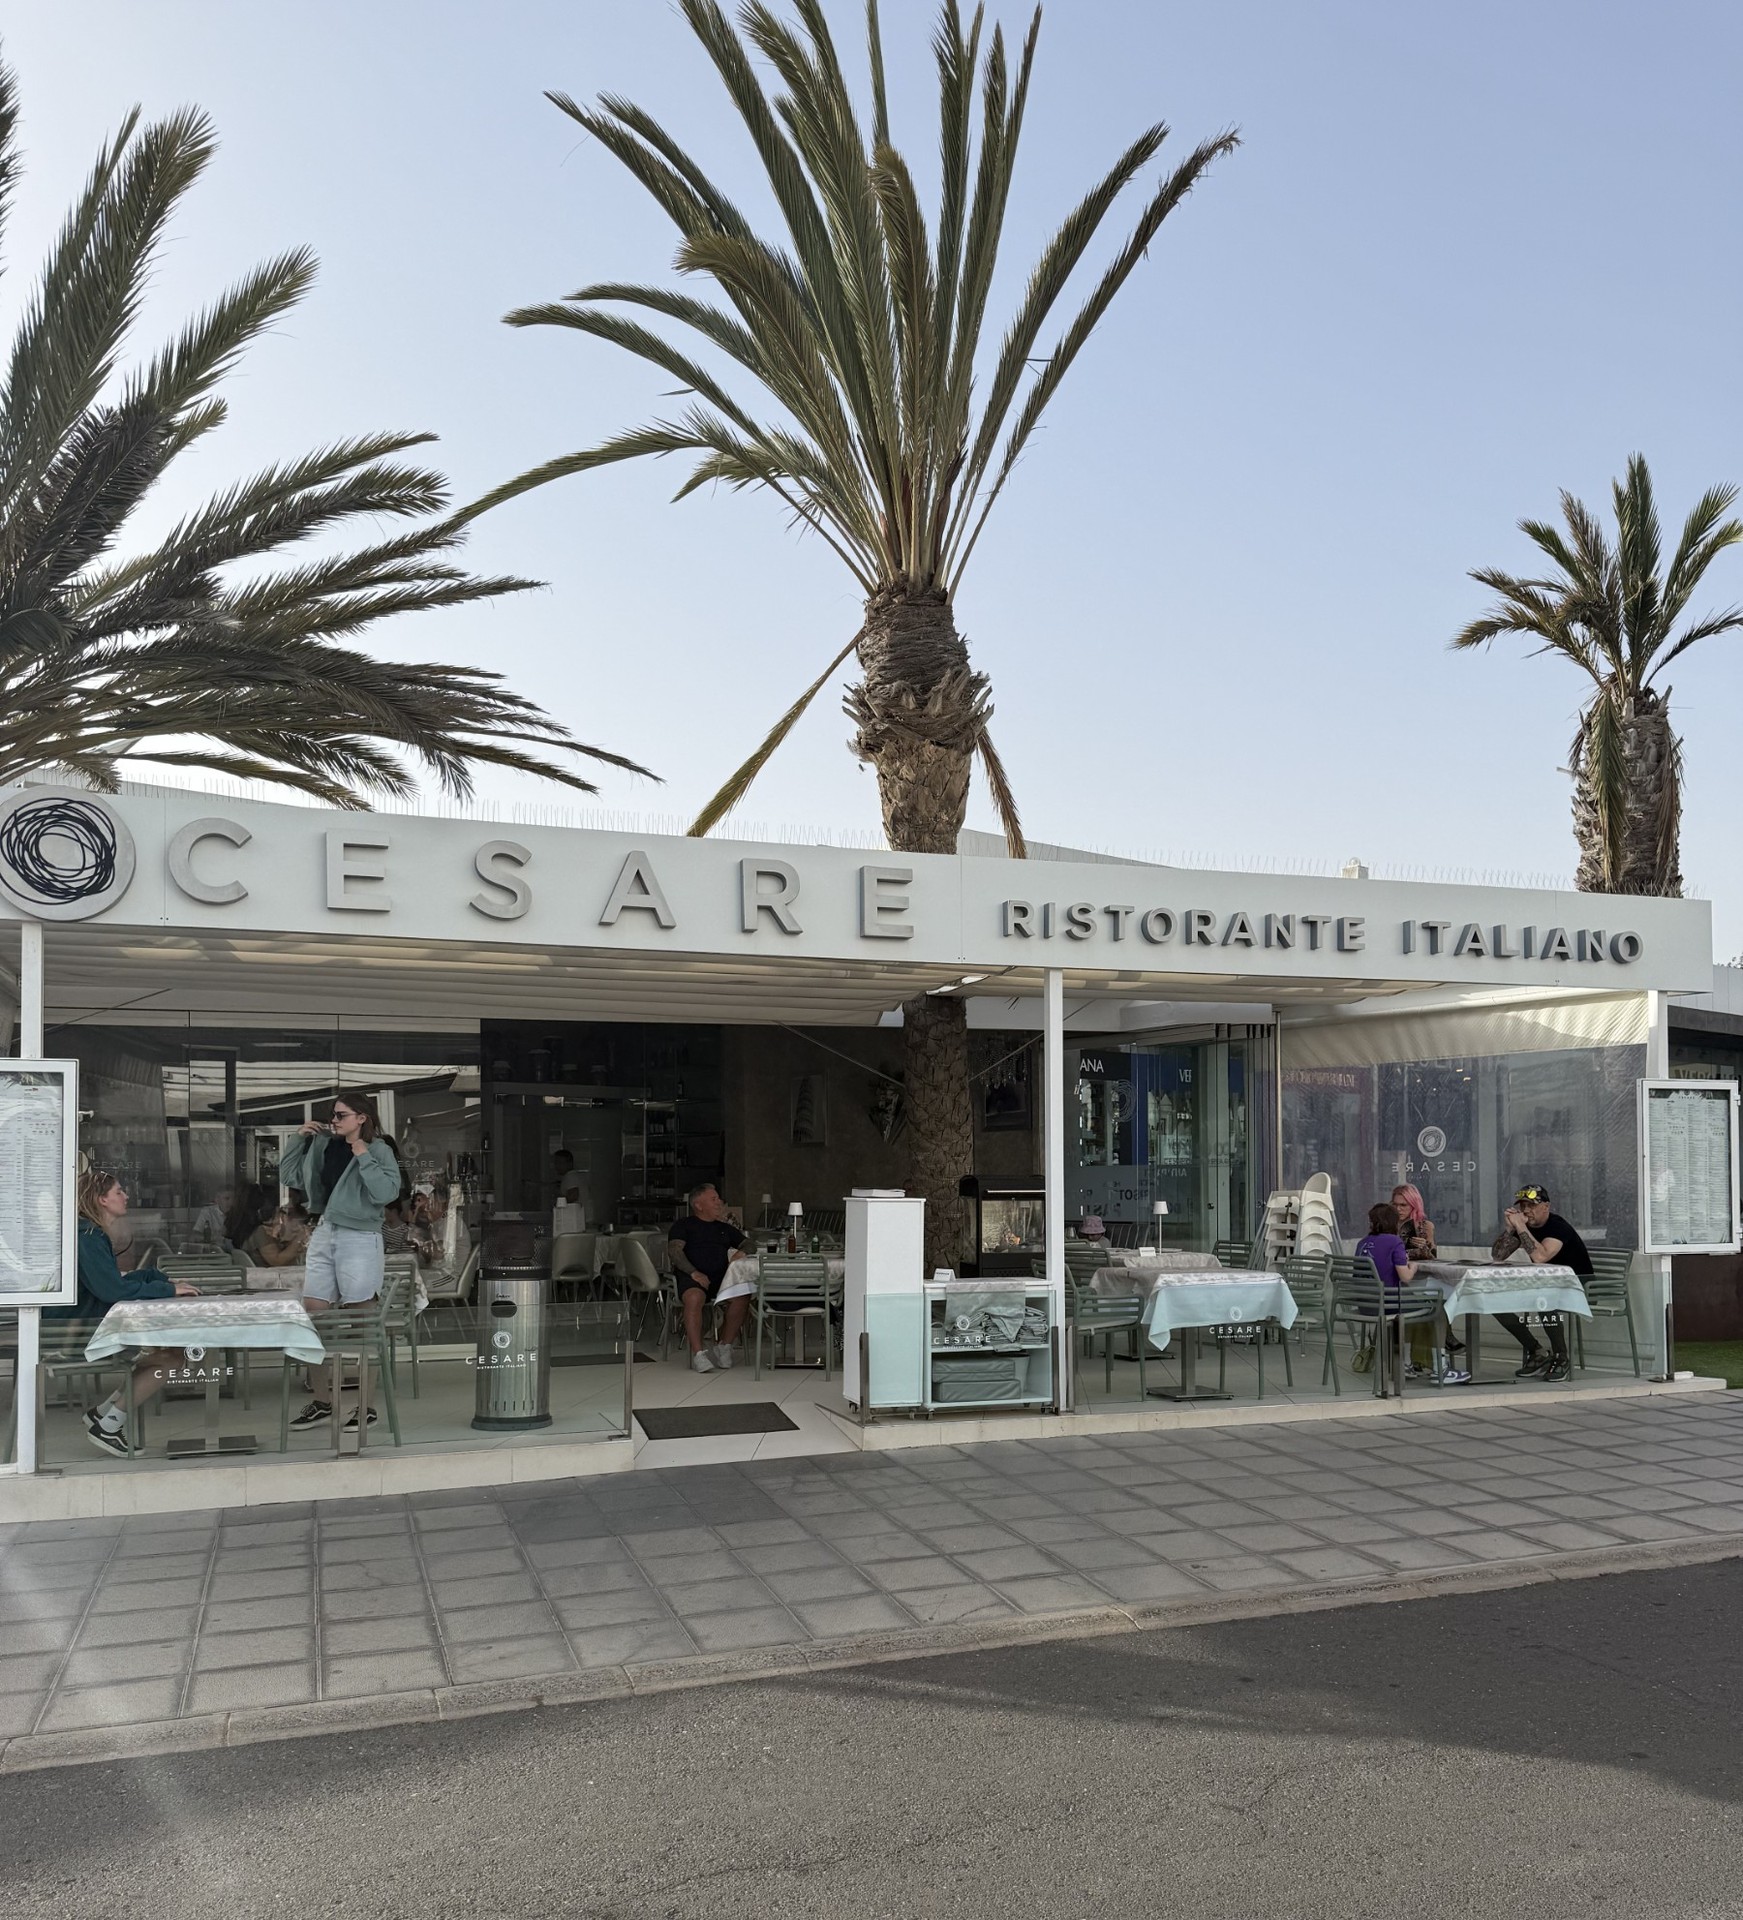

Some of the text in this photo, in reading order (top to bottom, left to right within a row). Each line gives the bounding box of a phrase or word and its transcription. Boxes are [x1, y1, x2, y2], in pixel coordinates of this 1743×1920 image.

[168, 817, 1643, 964] CESARE RISTORANTE ITALIANO
[398, 1160, 435, 1168] ESARE
[1519, 1315, 1564, 1323] CESARE
[1209, 1326, 1261, 1334] CESARE
[933, 1335, 991, 1345] CESARE
[465, 1353, 537, 1365] CESARE
[154, 1366, 234, 1379] CESARE
